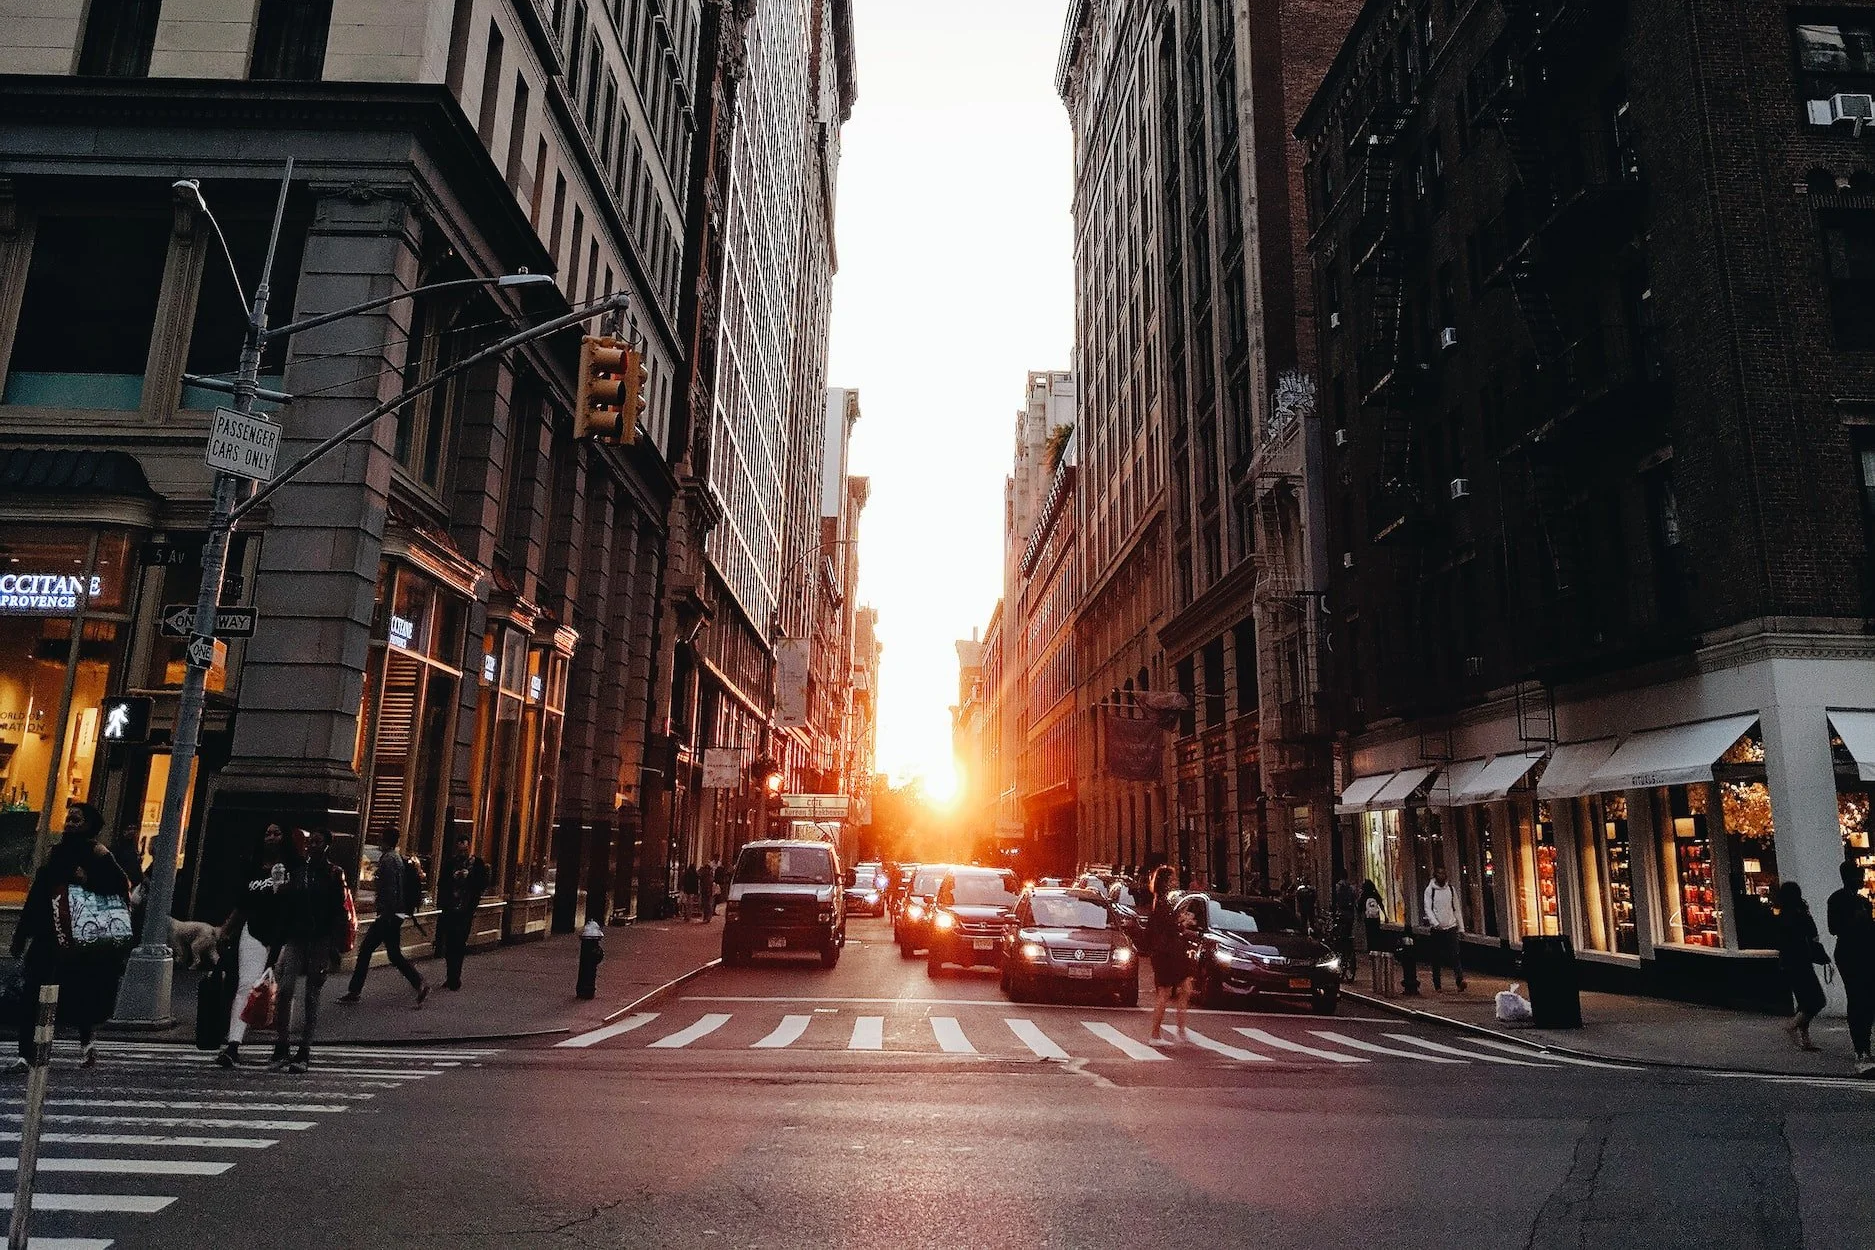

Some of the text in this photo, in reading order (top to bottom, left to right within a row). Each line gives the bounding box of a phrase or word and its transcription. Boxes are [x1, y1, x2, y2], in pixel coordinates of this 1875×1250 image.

[217, 416, 276, 449] PASSENGER
[212, 439, 271, 471] CARS ONLY
[156, 549, 162, 563] 5
[0, 595, 77, 608] PROVENCE
[219, 616, 247, 629] WAY
